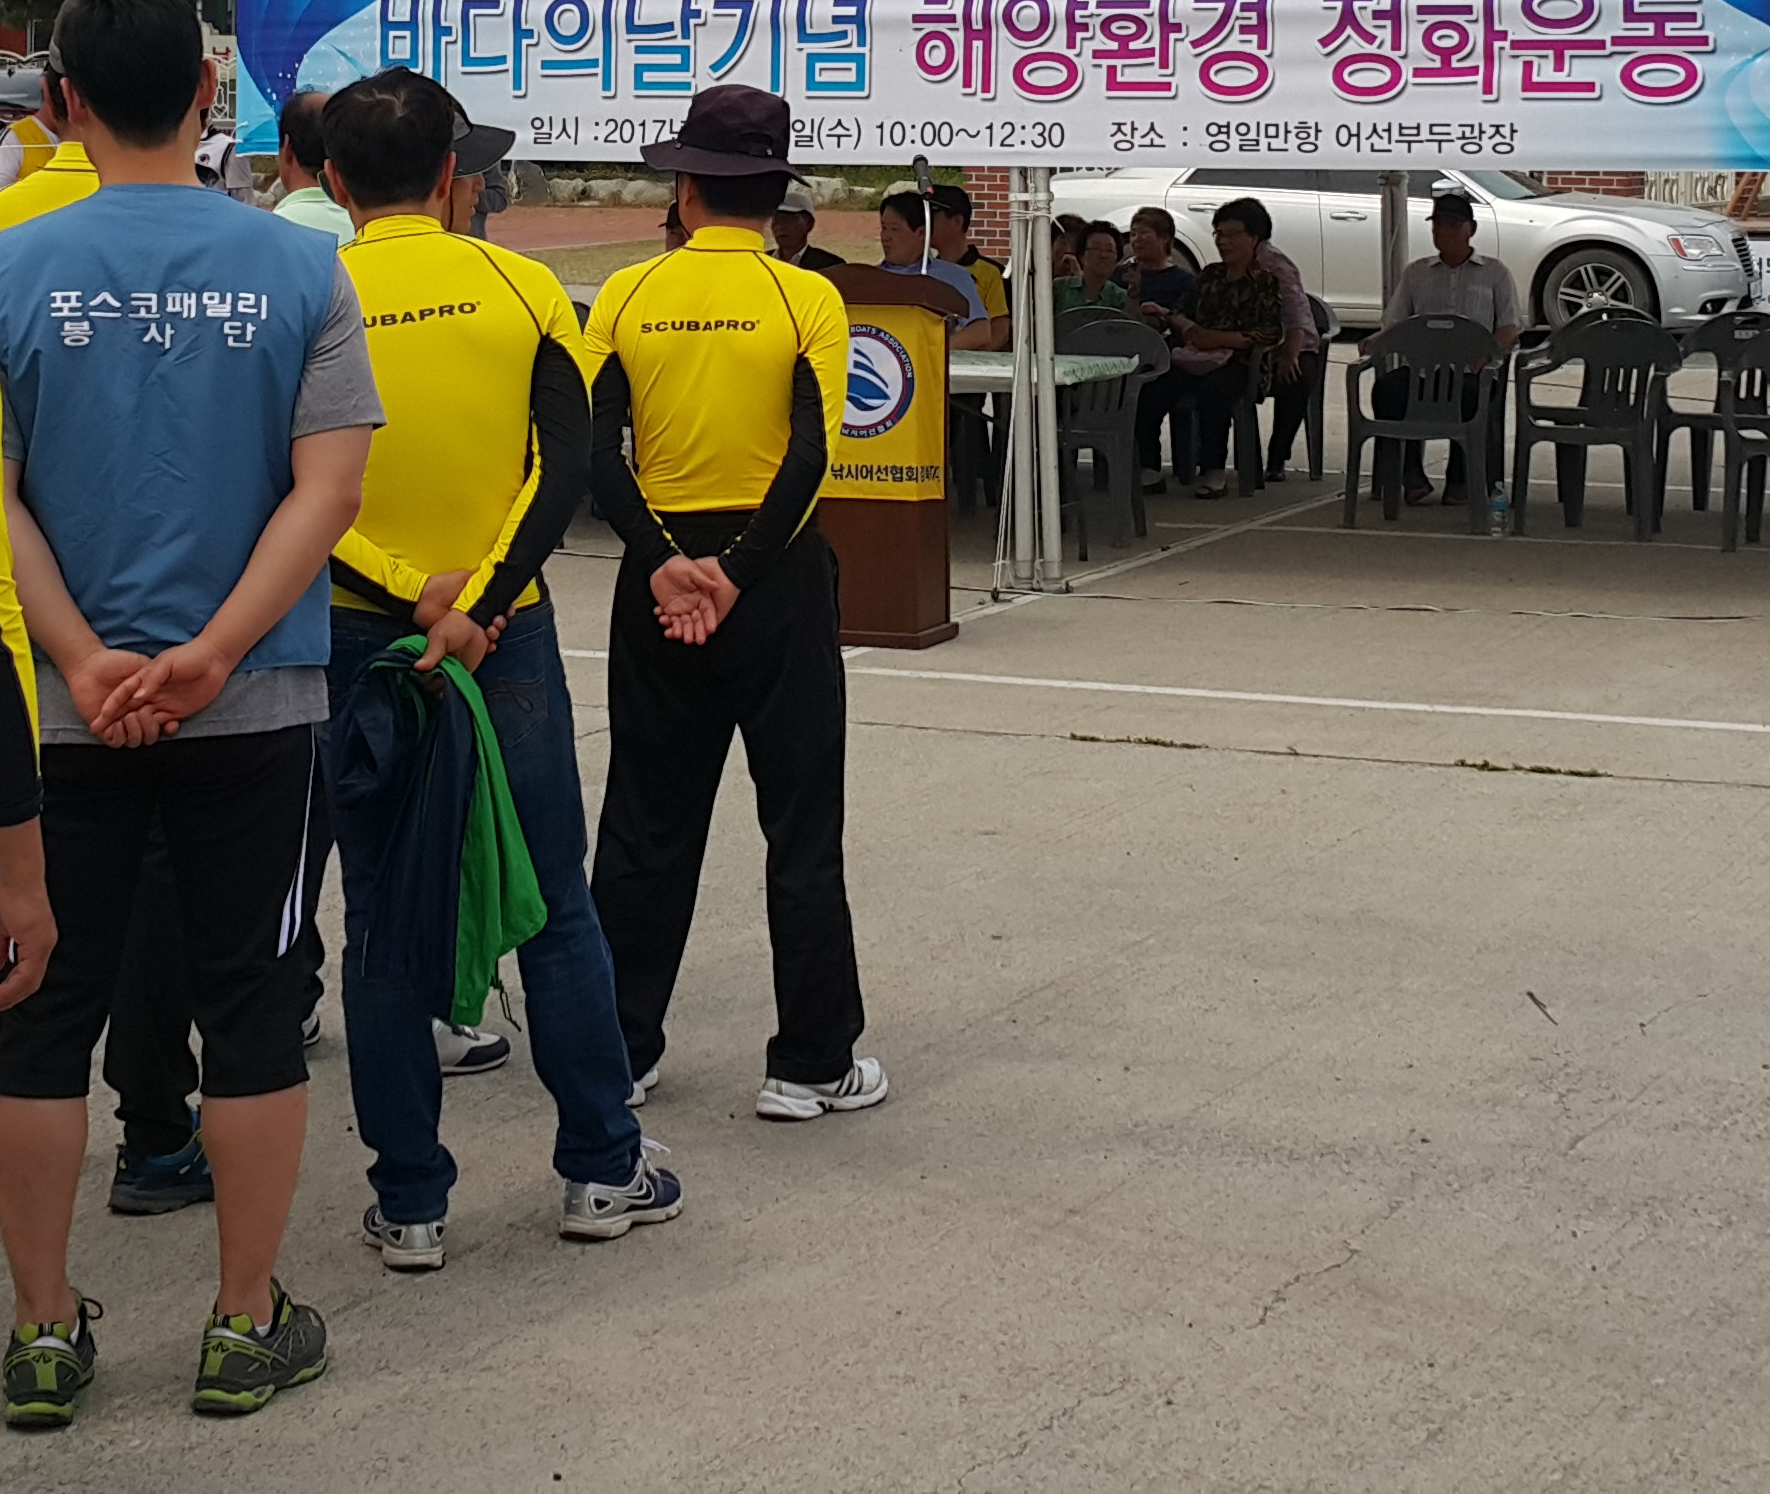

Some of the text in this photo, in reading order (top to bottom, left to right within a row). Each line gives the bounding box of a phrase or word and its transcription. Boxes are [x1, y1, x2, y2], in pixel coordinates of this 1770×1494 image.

[529, 117, 579, 146] 일시
[874, 120, 1066, 148] 10:00~12:30
[1109, 120, 1167, 152] 장소
[1204, 120, 1323, 153] 영일만항
[1335, 120, 1519, 155] 어선부두광장
[49, 290, 268, 321] 포스코패밀리
[363, 302, 477, 329] UBAPRO
